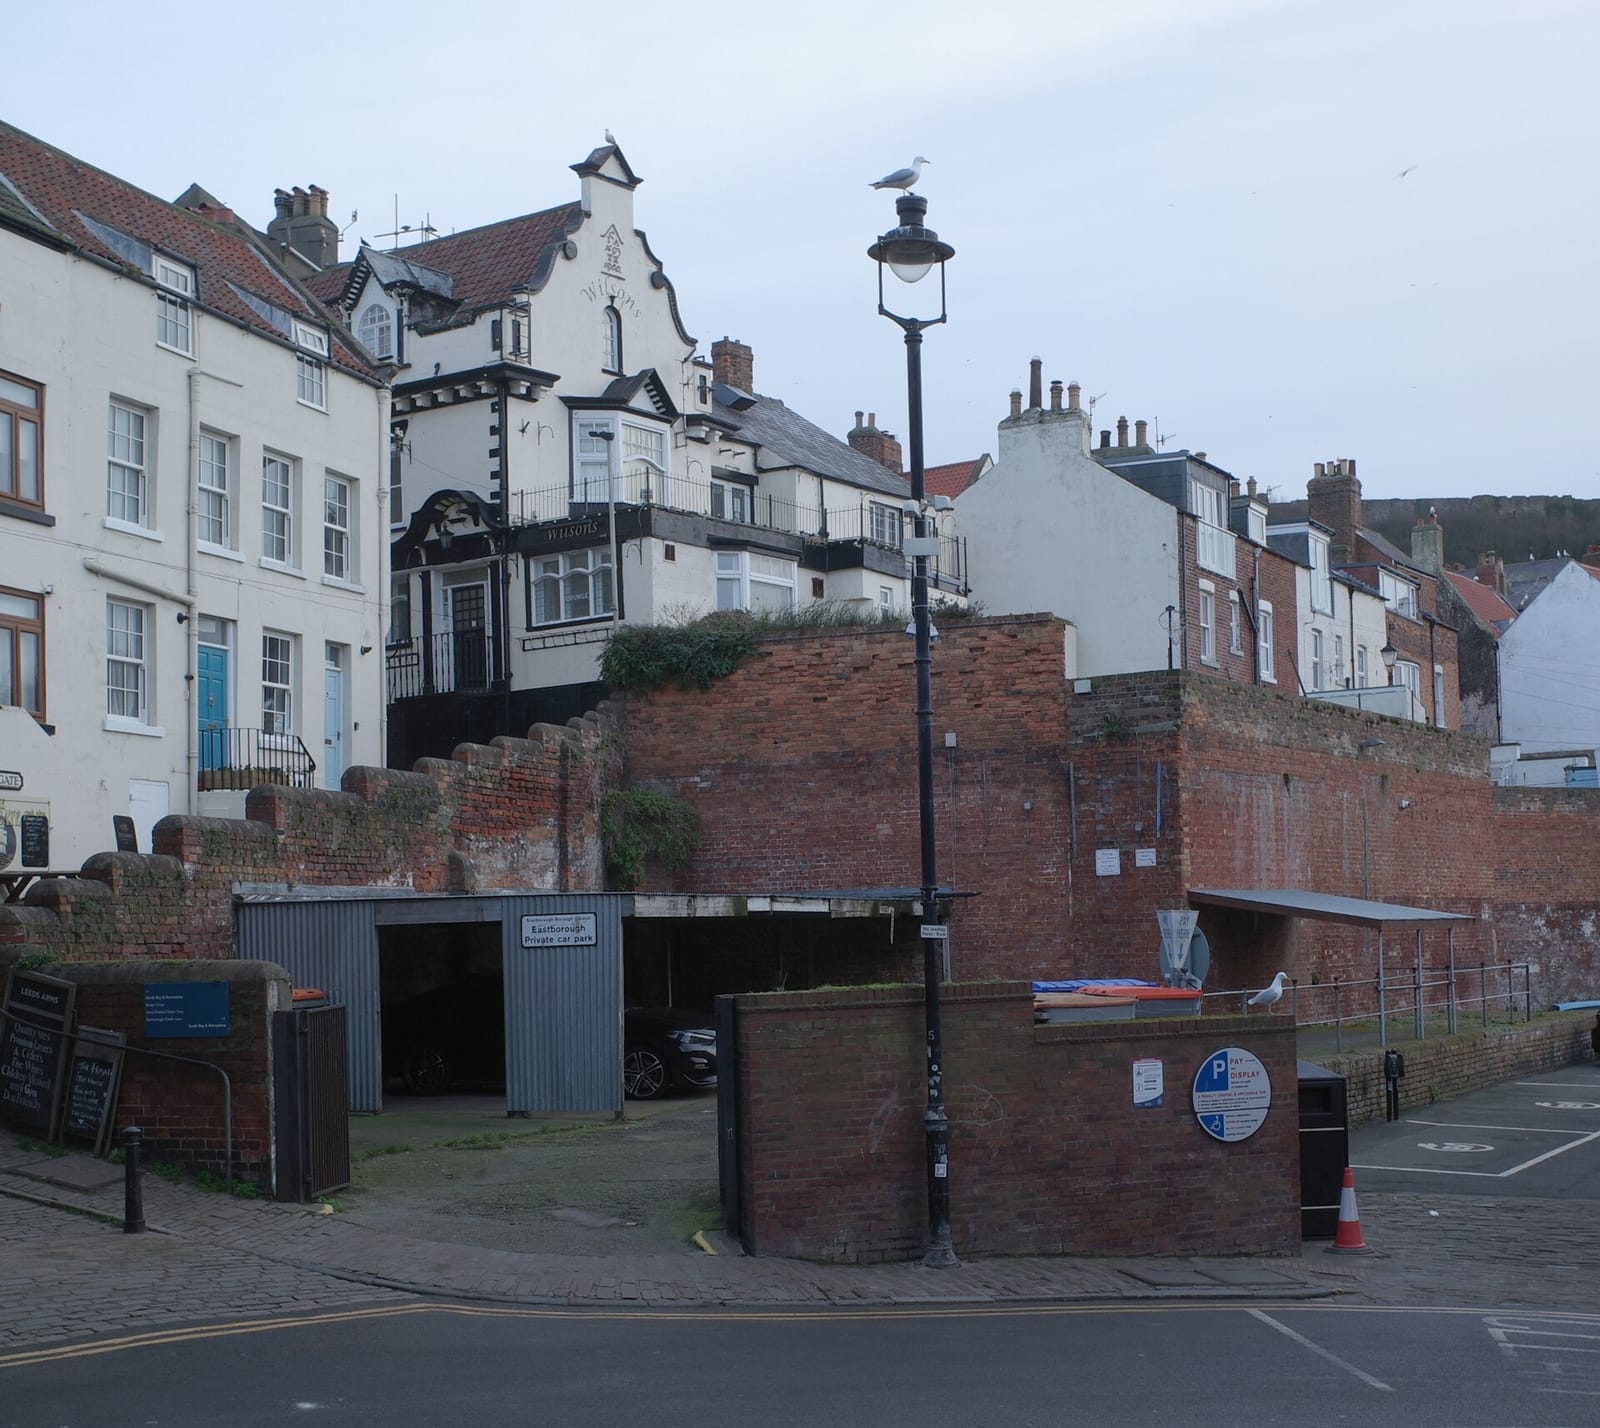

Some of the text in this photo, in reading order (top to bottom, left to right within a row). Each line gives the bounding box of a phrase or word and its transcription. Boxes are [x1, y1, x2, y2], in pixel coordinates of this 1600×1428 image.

[580, 276, 642, 319] Wilsons
[1179, 915, 1190, 926] PAY
[531, 924, 586, 934] Eastborough
[524, 934, 593, 944] Private car park
[20, 987, 59, 1005] LEEDS ARMS
[1230, 1057, 1244, 1065] PAY
[1213, 1059, 1226, 1080] P
[1230, 1072, 1260, 1080] DISPLAY
